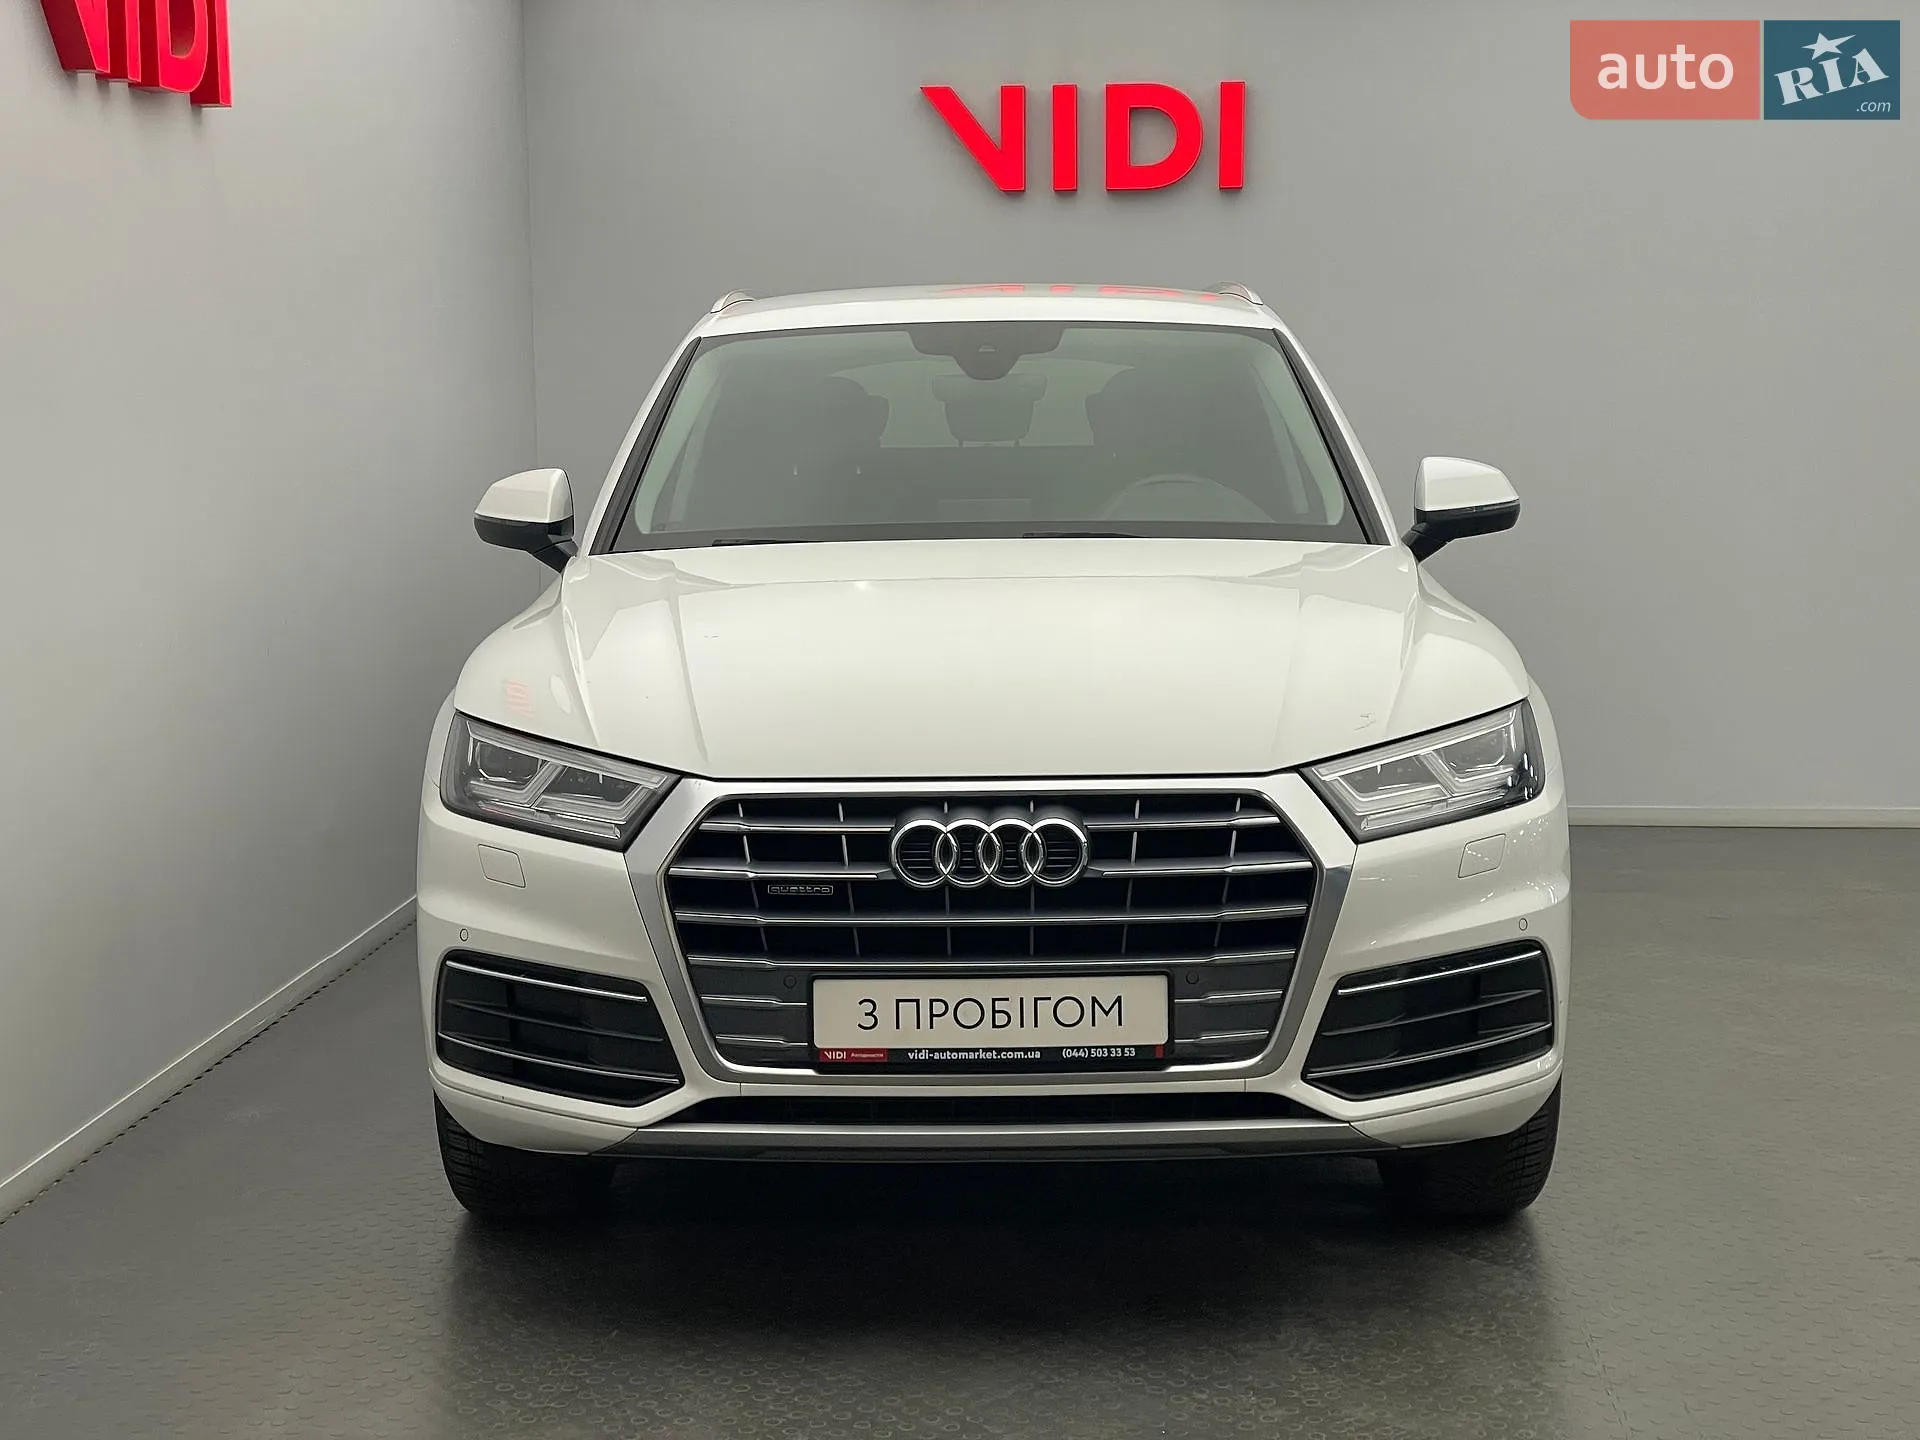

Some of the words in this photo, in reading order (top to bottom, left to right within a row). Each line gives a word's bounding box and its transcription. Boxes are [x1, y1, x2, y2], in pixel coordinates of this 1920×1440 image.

[920, 81, 1245, 191] VIDI
[770, 886, 830, 894] quattro
[857, 999, 878, 1030] З
[896, 996, 1122, 1030] ПРОБІГОМ
[824, 1051, 846, 1060] VIDI
[908, 1049, 1041, 1060] vidi-automarket.com.ua
[1062, 1048, 1088, 1058] (044)
[1090, 1048, 1108, 1057] 503
[1110, 1048, 1122, 1057] 33
[1124, 1047, 1136, 1057] 53
